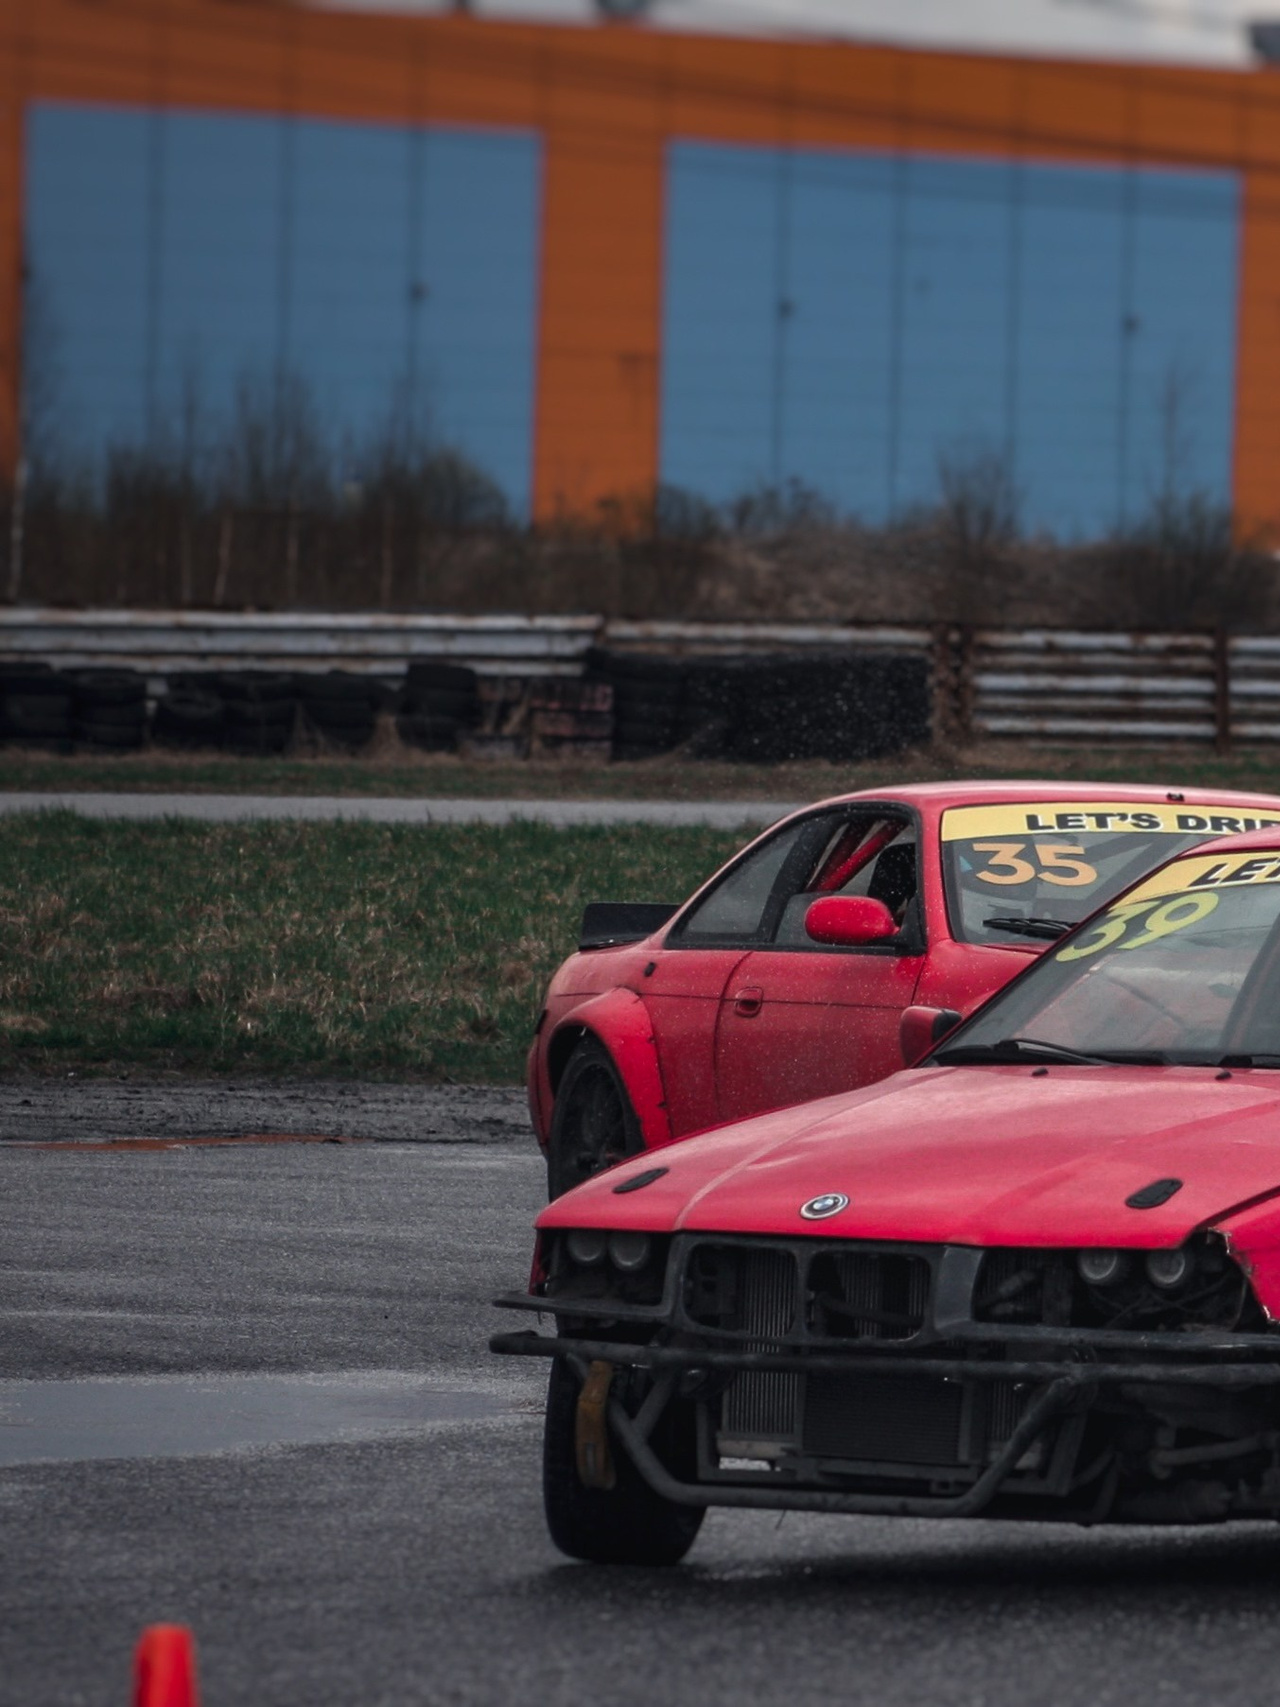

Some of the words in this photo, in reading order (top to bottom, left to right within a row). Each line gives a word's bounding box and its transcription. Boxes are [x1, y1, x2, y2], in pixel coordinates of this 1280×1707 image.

[1026, 813, 1161, 831] LET'S
[972, 842, 1098, 886] 35
[1055, 892, 1219, 962] 39
